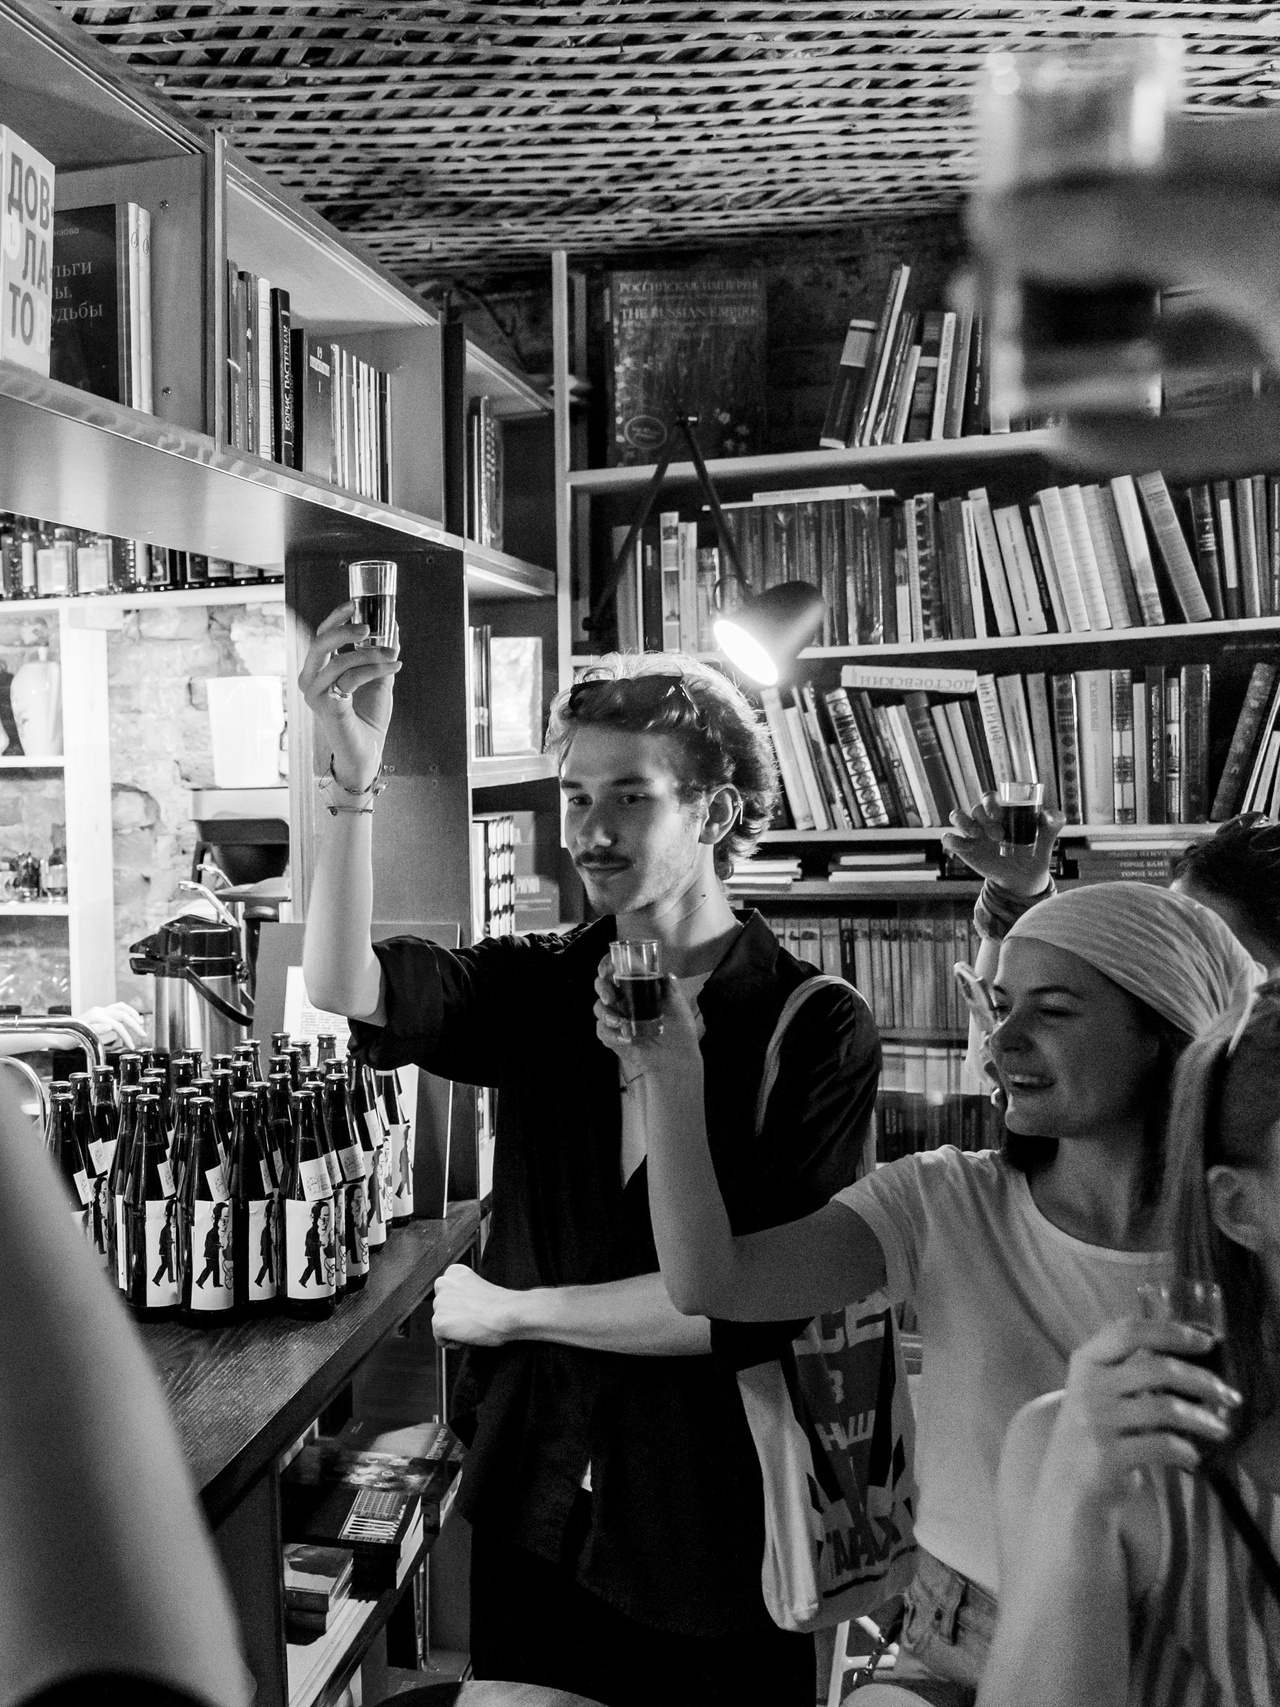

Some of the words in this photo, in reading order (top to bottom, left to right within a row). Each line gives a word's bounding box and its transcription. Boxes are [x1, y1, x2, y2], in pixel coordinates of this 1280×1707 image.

[52, 286, 73, 300] ы.
[283, 324, 291, 395] ПАСТЕРНАК
[284, 397, 292, 432] БОРИС
